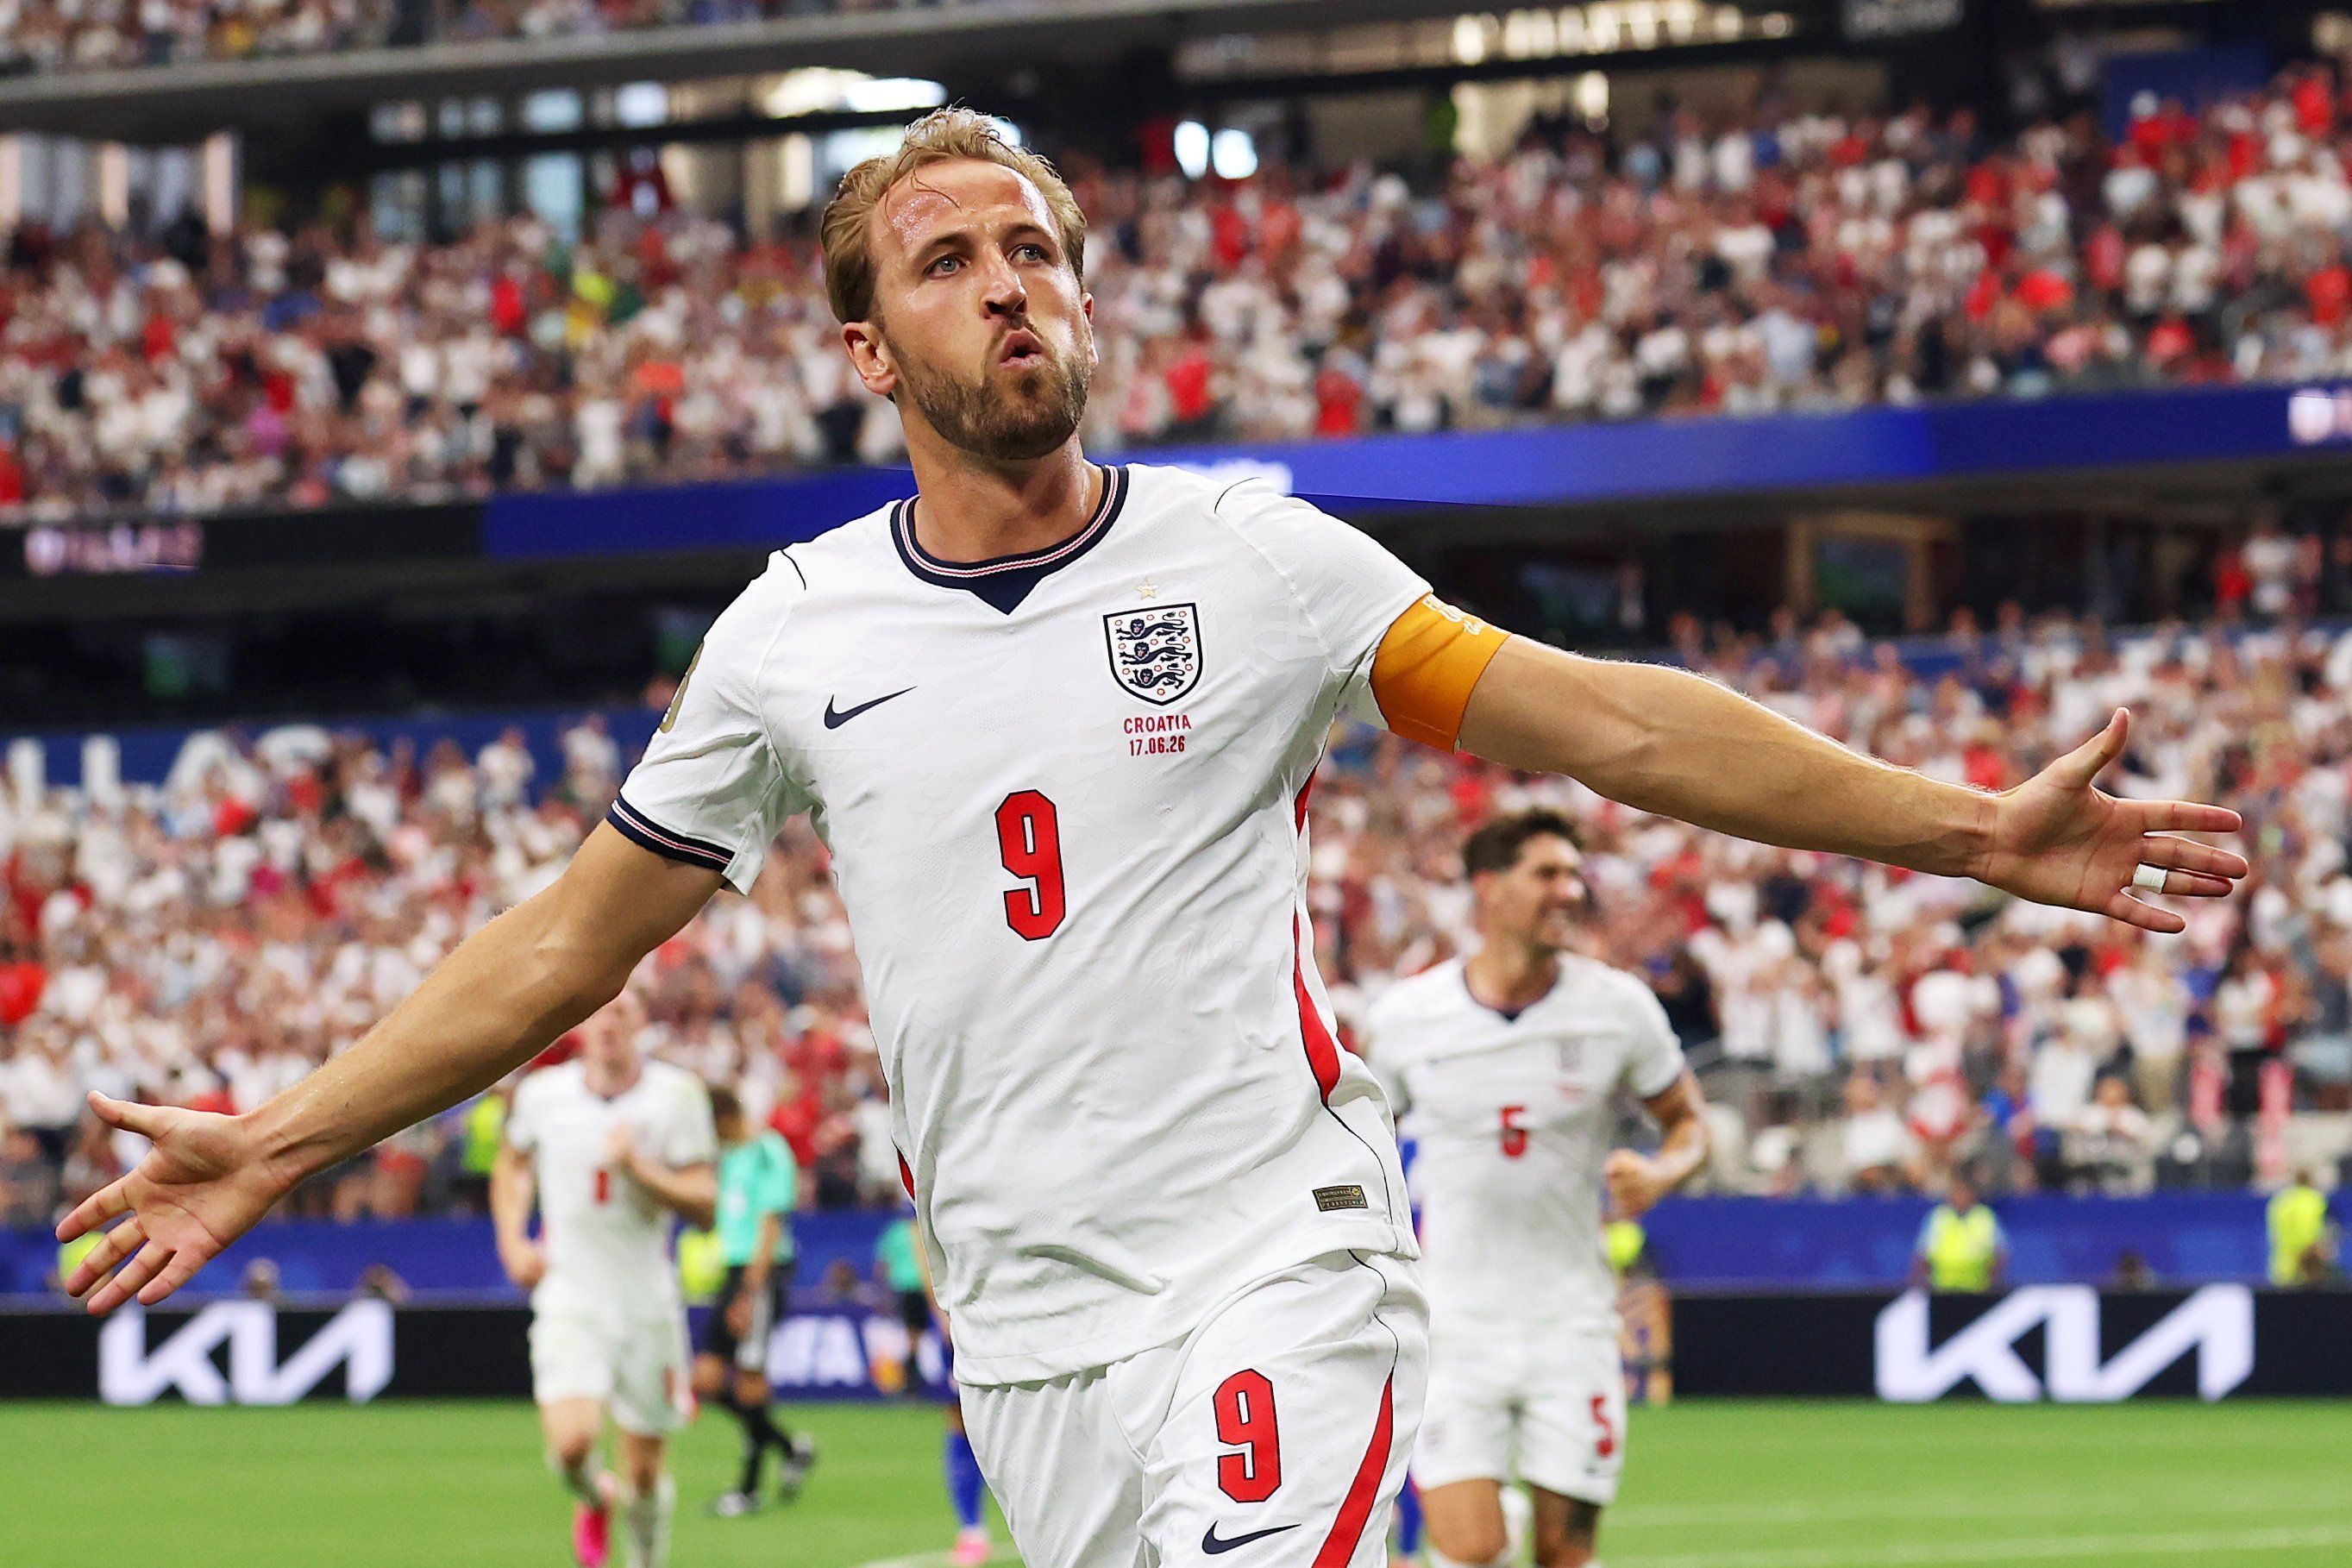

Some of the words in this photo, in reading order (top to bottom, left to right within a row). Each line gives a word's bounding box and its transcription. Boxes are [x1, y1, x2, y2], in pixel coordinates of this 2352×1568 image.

[1123, 714, 1192, 734] CROATIA
[1129, 735, 1185, 756] 17.06.26
[994, 788, 1066, 942] 9
[1499, 1105, 1528, 1157] 5
[97, 1299, 395, 1406] KIA
[1872, 1282, 2257, 1402] KIA
[1213, 1368, 1283, 1503] 9
[1590, 1393, 1615, 1459] 5
